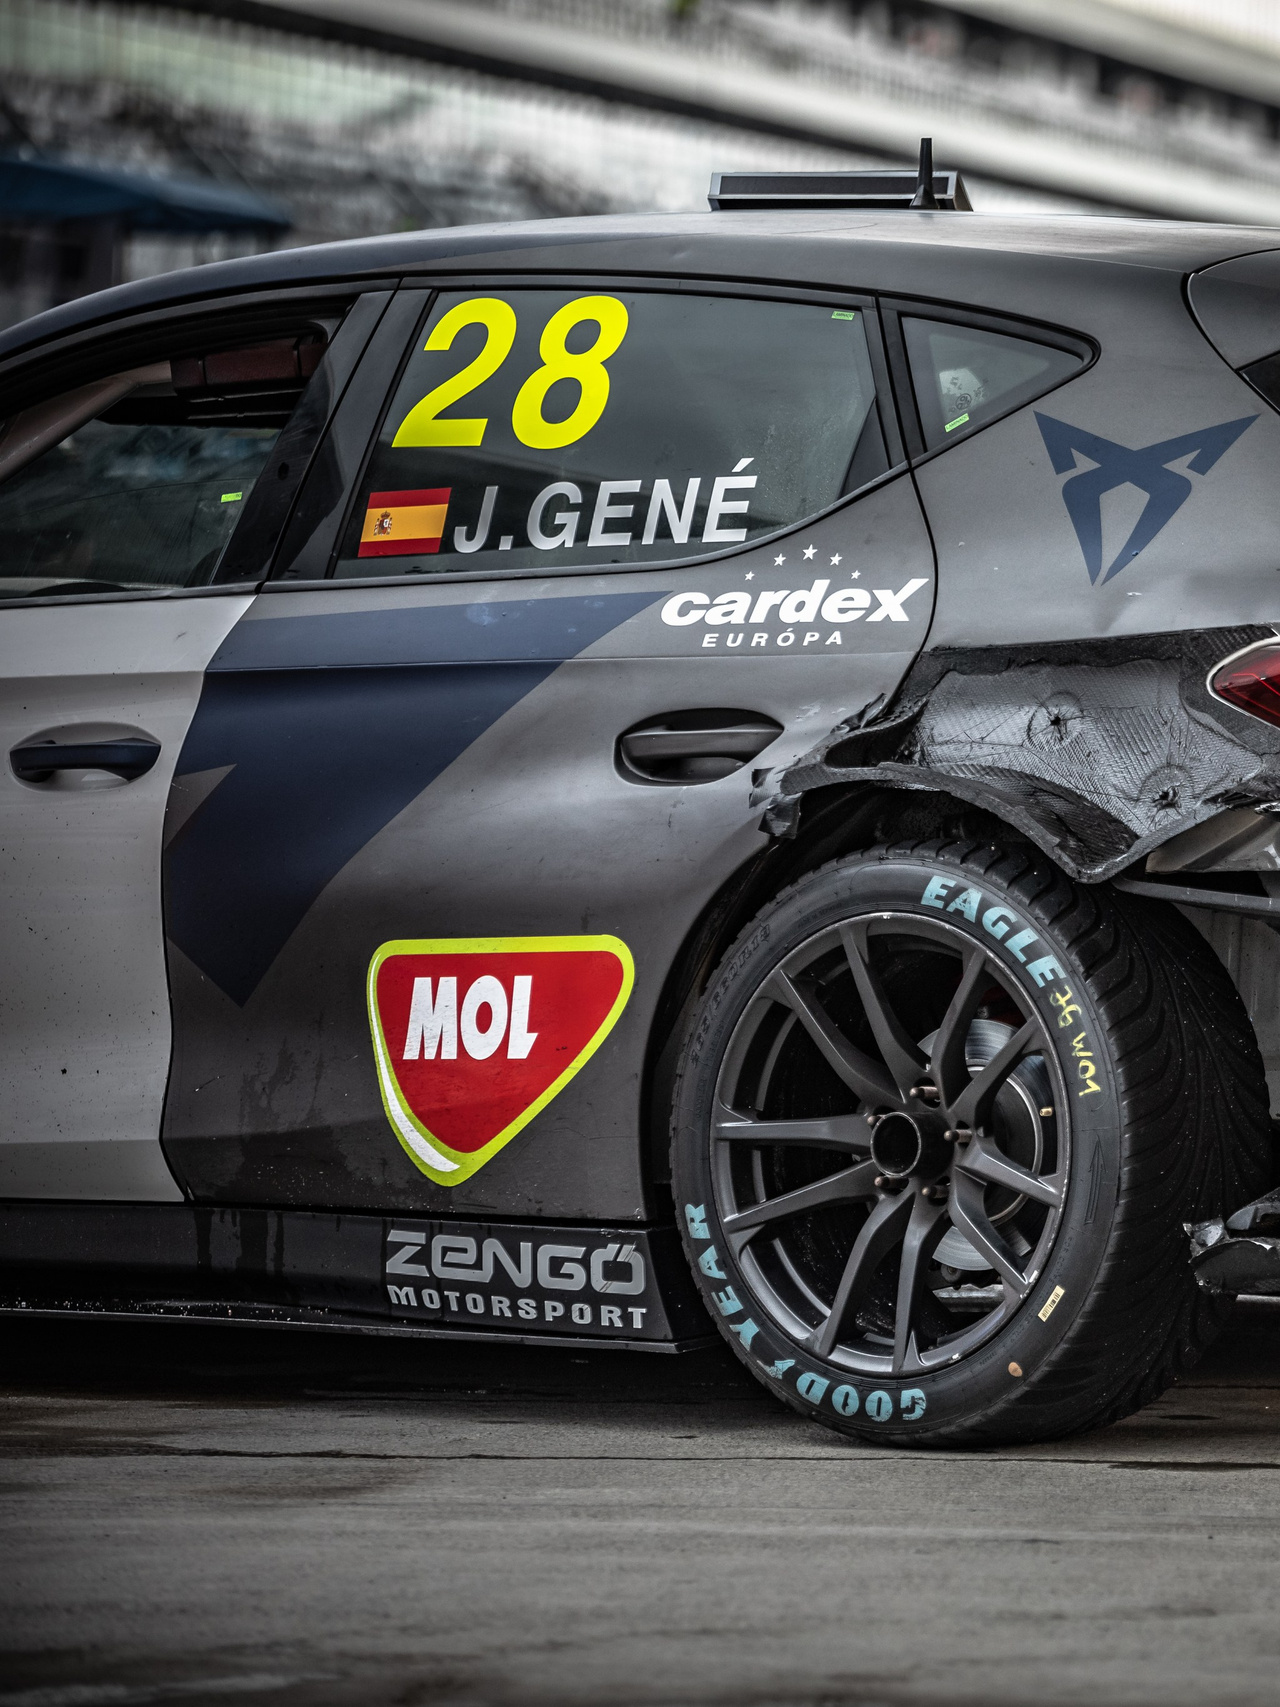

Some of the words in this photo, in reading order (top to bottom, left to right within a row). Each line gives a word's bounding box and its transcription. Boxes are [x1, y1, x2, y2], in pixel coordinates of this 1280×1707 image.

[392, 295, 629, 449] 28
[452, 457, 757, 554] J.GENÉ
[661, 577, 929, 628] cardex
[702, 628, 844, 648] EURÓPA
[921, 874, 1067, 989] EAGLE
[403, 975, 539, 1061] MOL
[386, 1284, 647, 1329] MOTORSPORT
